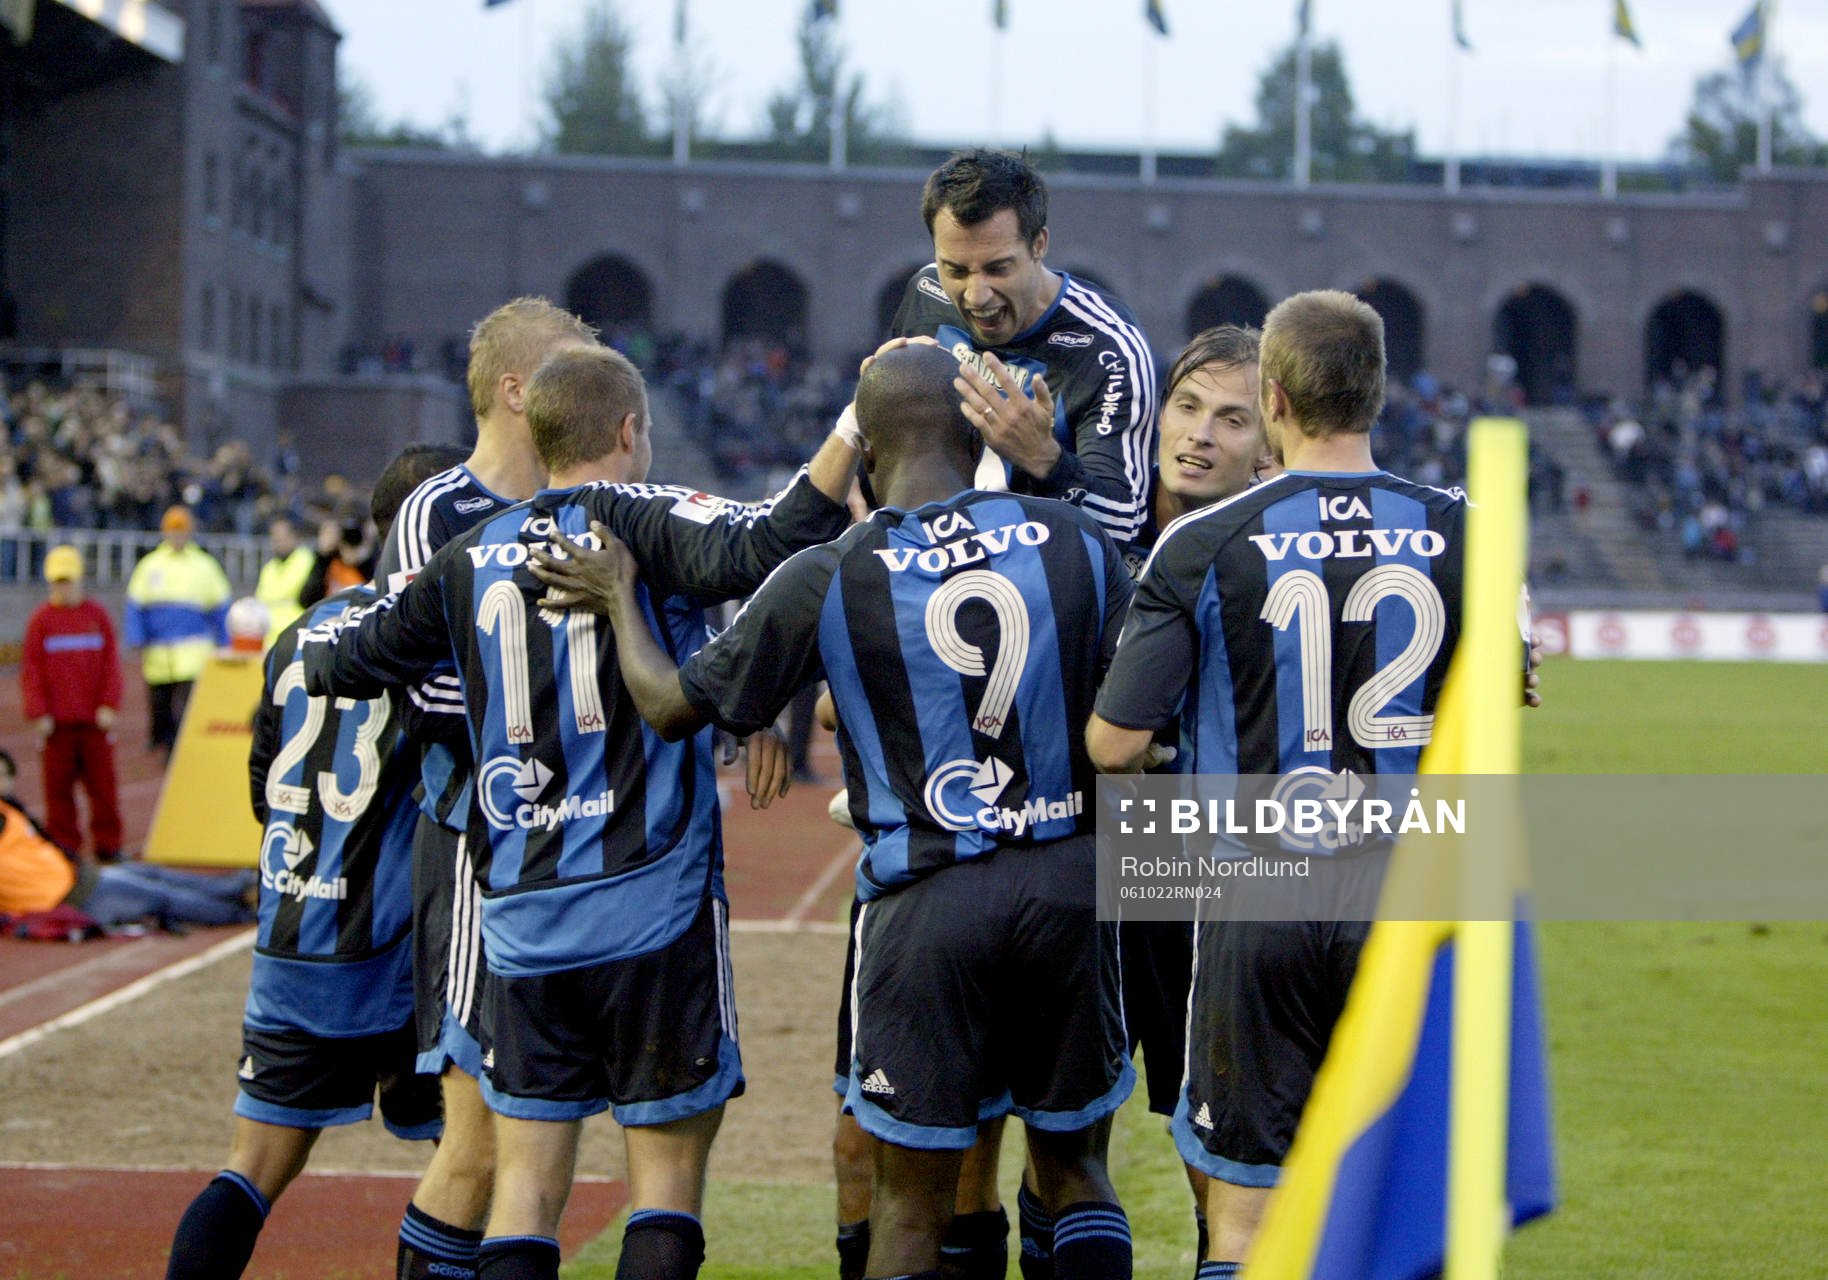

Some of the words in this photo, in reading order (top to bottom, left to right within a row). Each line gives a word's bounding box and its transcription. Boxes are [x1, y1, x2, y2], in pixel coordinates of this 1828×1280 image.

[1318, 496, 1373, 521] ICA
[922, 511, 976, 544] ICA
[873, 521, 1051, 573] VOLVO
[1248, 528, 1447, 561] VOLVO
[476, 580, 607, 745] 11
[925, 569, 1030, 740] 9
[1259, 563, 1446, 752] 12
[508, 725, 531, 739] ICA
[577, 714, 602, 728] ICA
[976, 716, 1002, 729] ICA
[1307, 729, 1330, 742] ICA
[1387, 726, 1407, 740] ICA
[265, 661, 391, 823] 23
[515, 789, 615, 831] CityMail
[976, 790, 1083, 836] CityMail
[274, 869, 348, 902] CityMail
